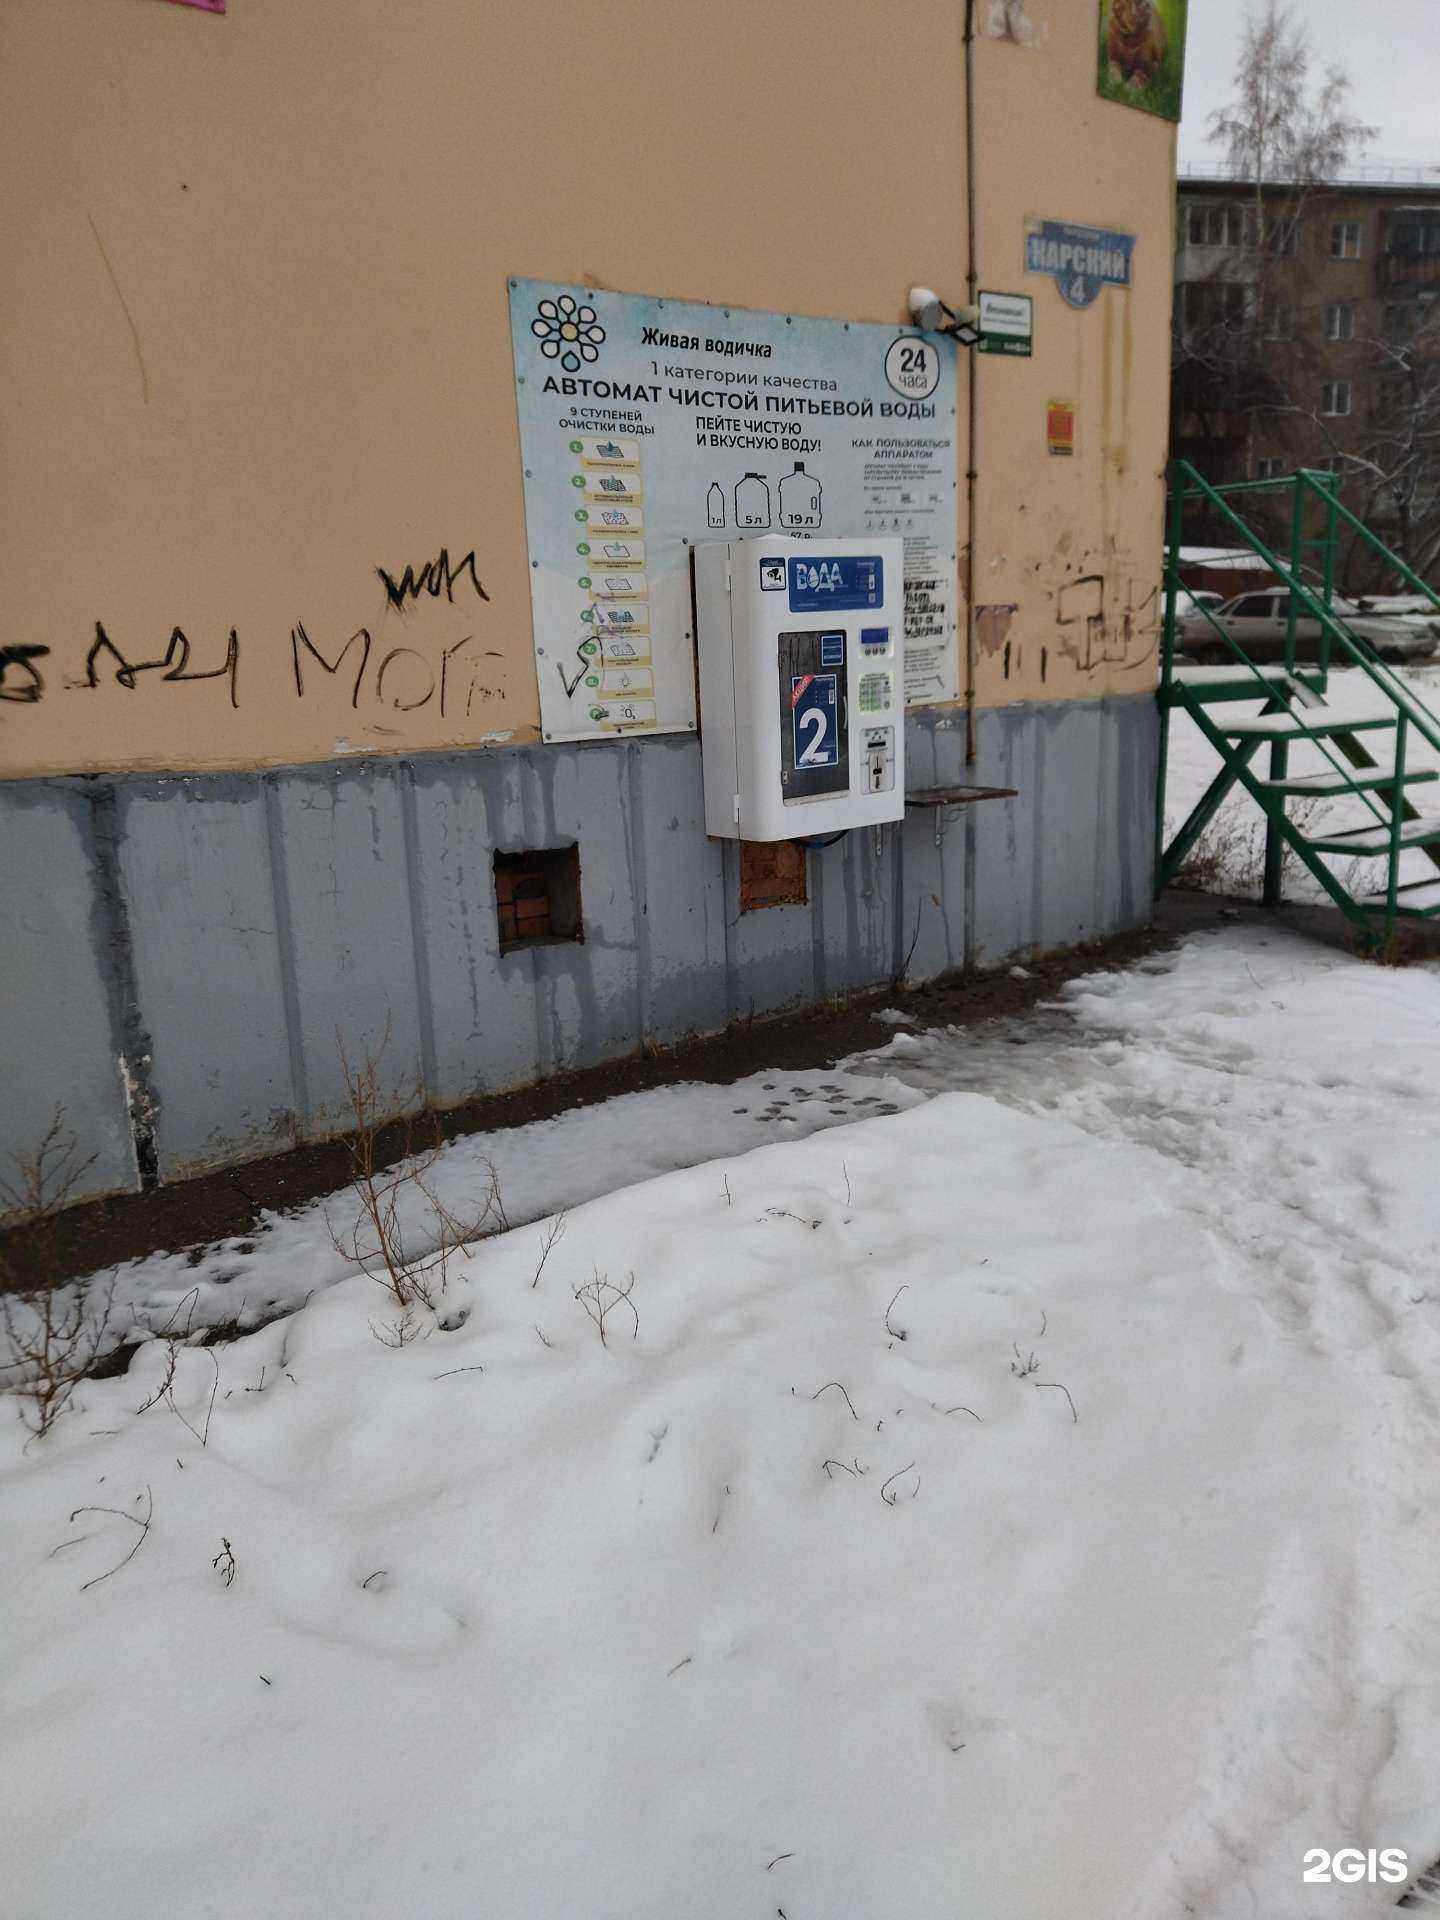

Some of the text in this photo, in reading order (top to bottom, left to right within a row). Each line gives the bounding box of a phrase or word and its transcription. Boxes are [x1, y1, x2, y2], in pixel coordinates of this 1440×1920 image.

[641, 326, 772, 358] Живая водичка
[900, 348, 927, 373] 24
[651, 361, 837, 391] 1 категории качества
[898, 375, 928, 389] часа
[542, 376, 936, 420] АВТОМАТ ЧИСТОЙ ПИТЬЕВОЙ ВОДЫ
[569, 407, 642, 422] 9 СТУПЕНЕЙ
[558, 418, 655, 436] ОЧИСТКИ ВОДЫ
[696, 415, 802, 435] ПЕЙТЕ ЧИСТУЮ
[696, 433, 822, 453] И ВКУСНУЮ ВОДУ!
[851, 439, 873, 448] КАК
[873, 450, 934, 459] АППАРАТОМ
[745, 515, 753, 524] 5
[788, 514, 803, 525] 19
[796, 562, 844, 593] ВОДА
[799, 707, 829, 764] 2
